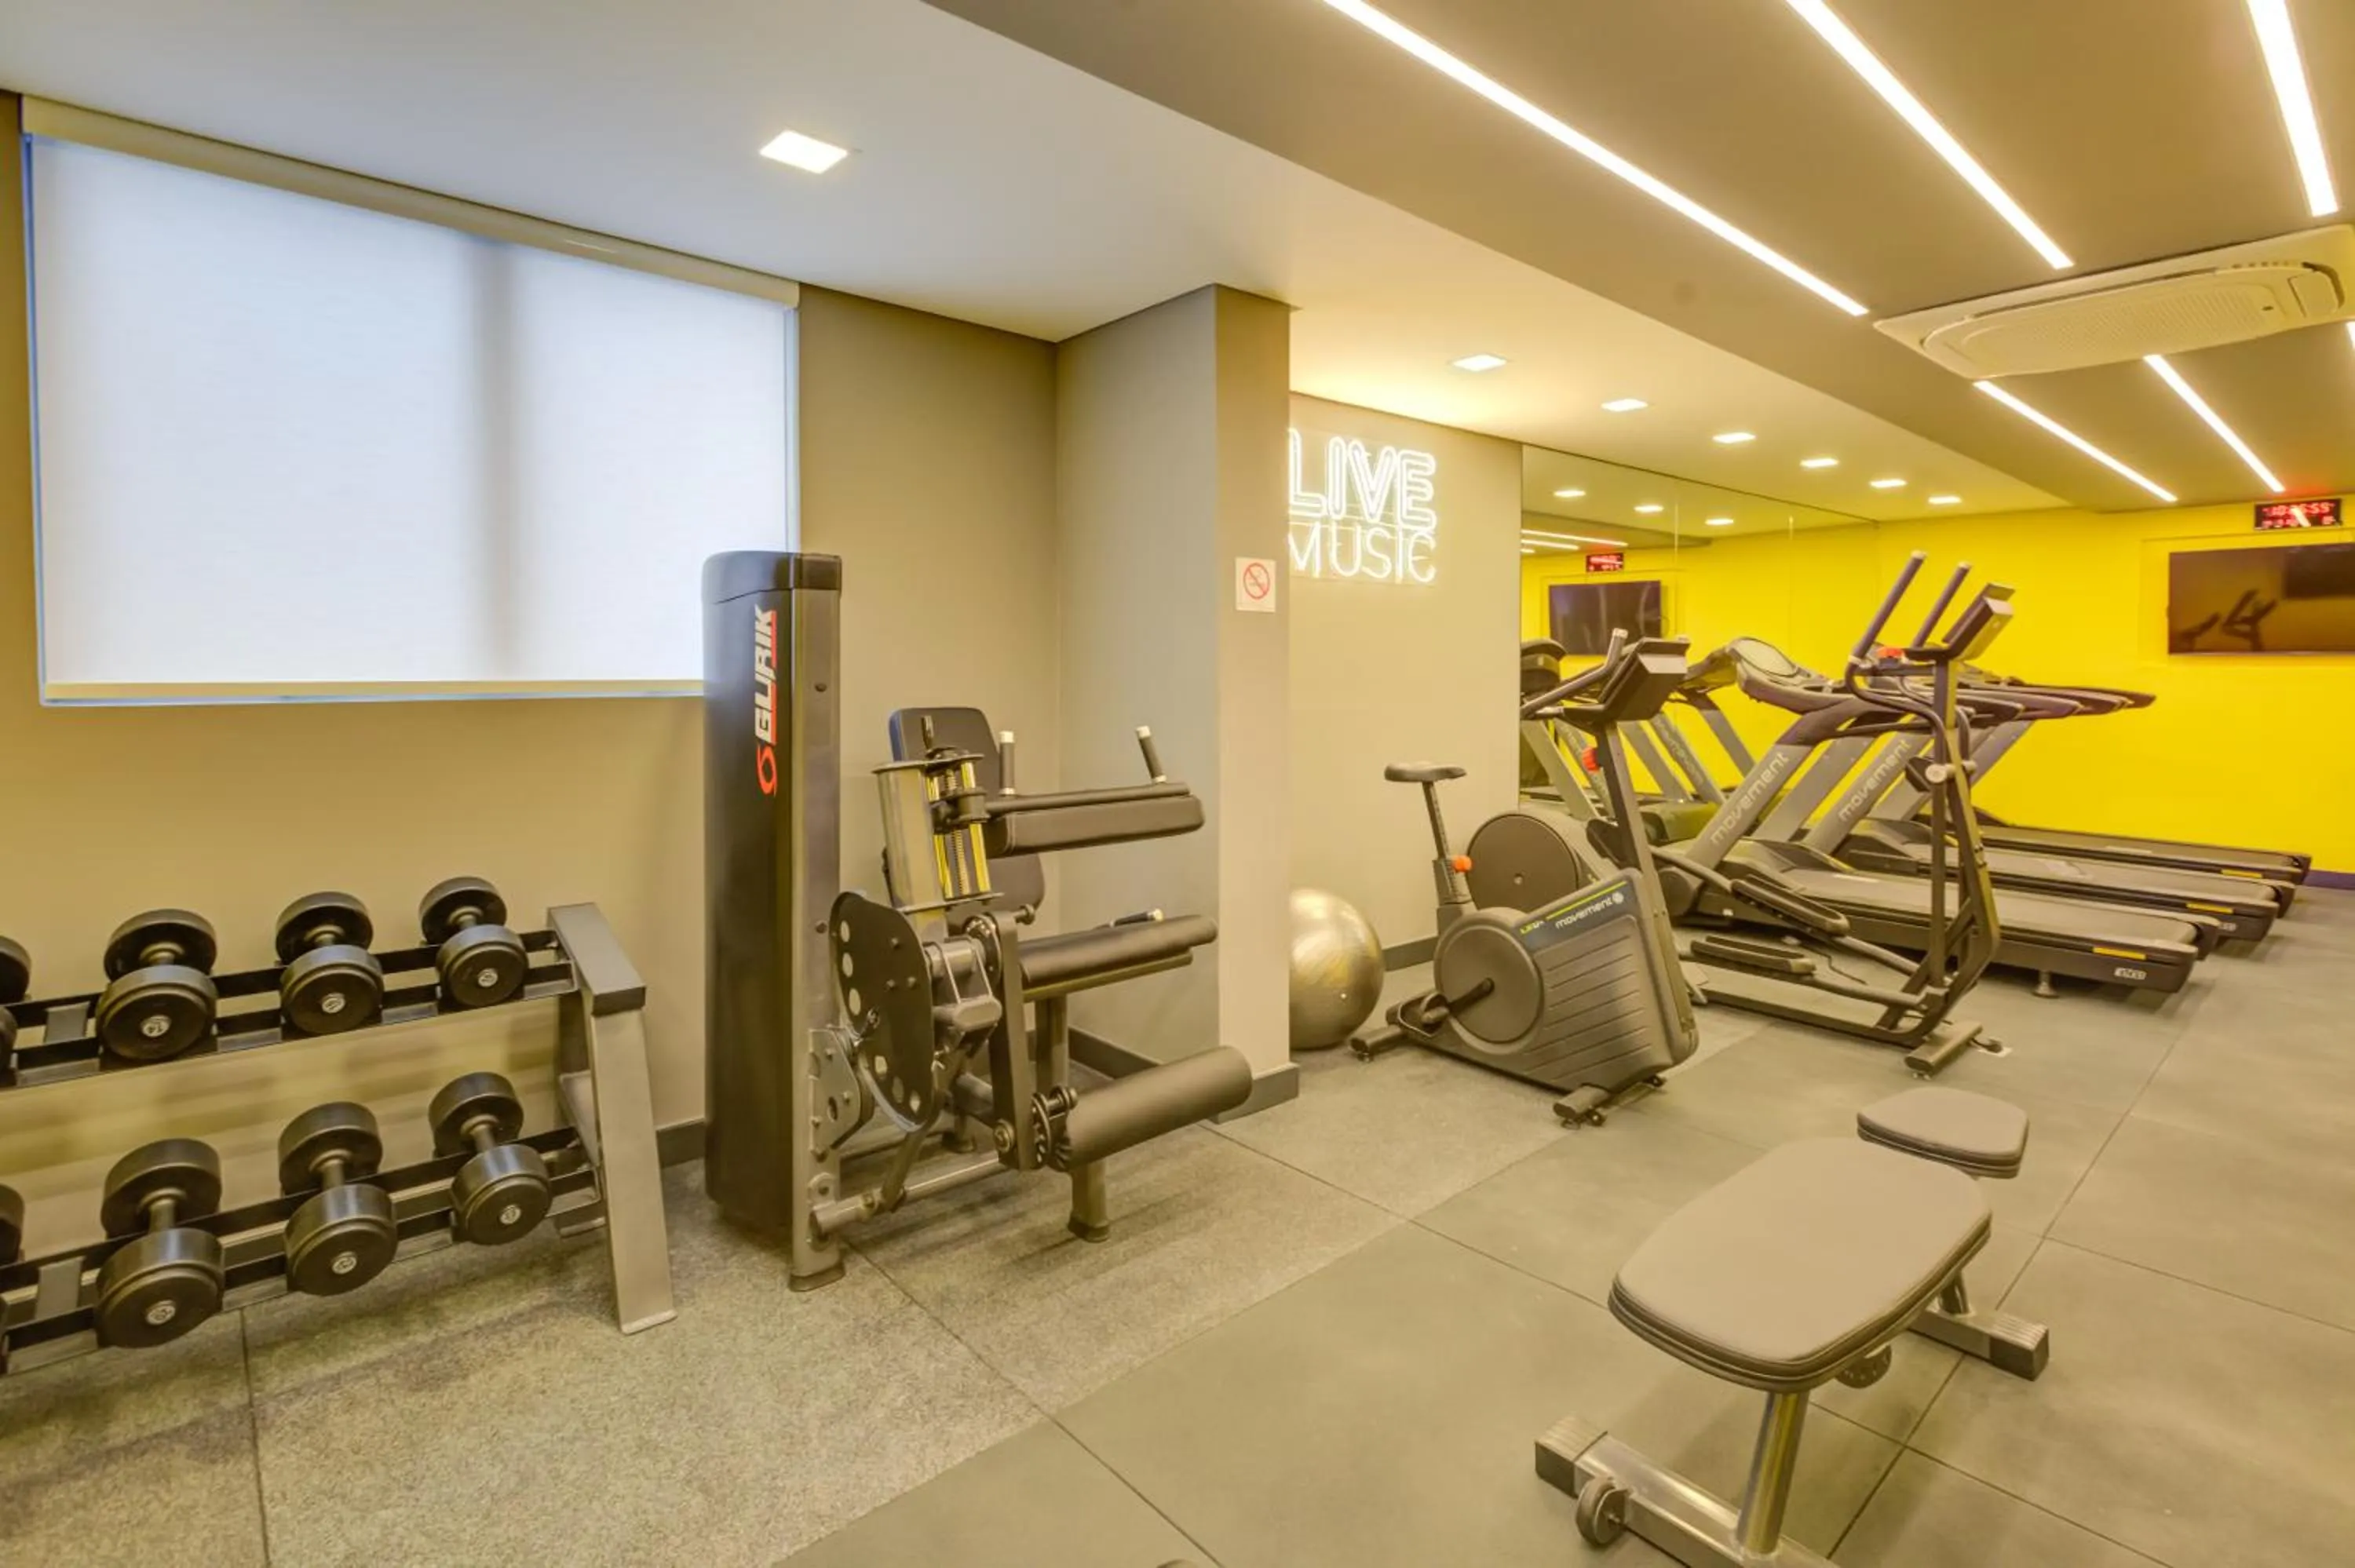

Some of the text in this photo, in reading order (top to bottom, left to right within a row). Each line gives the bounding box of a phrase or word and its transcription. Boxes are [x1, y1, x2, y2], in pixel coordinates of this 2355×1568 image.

[1289, 428, 1437, 531] LIVE
[1289, 521, 1437, 584] MUSIC
[1711, 752, 1789, 844] movement
[1838, 739, 1911, 822] movement
[1554, 897, 1613, 928] movement
